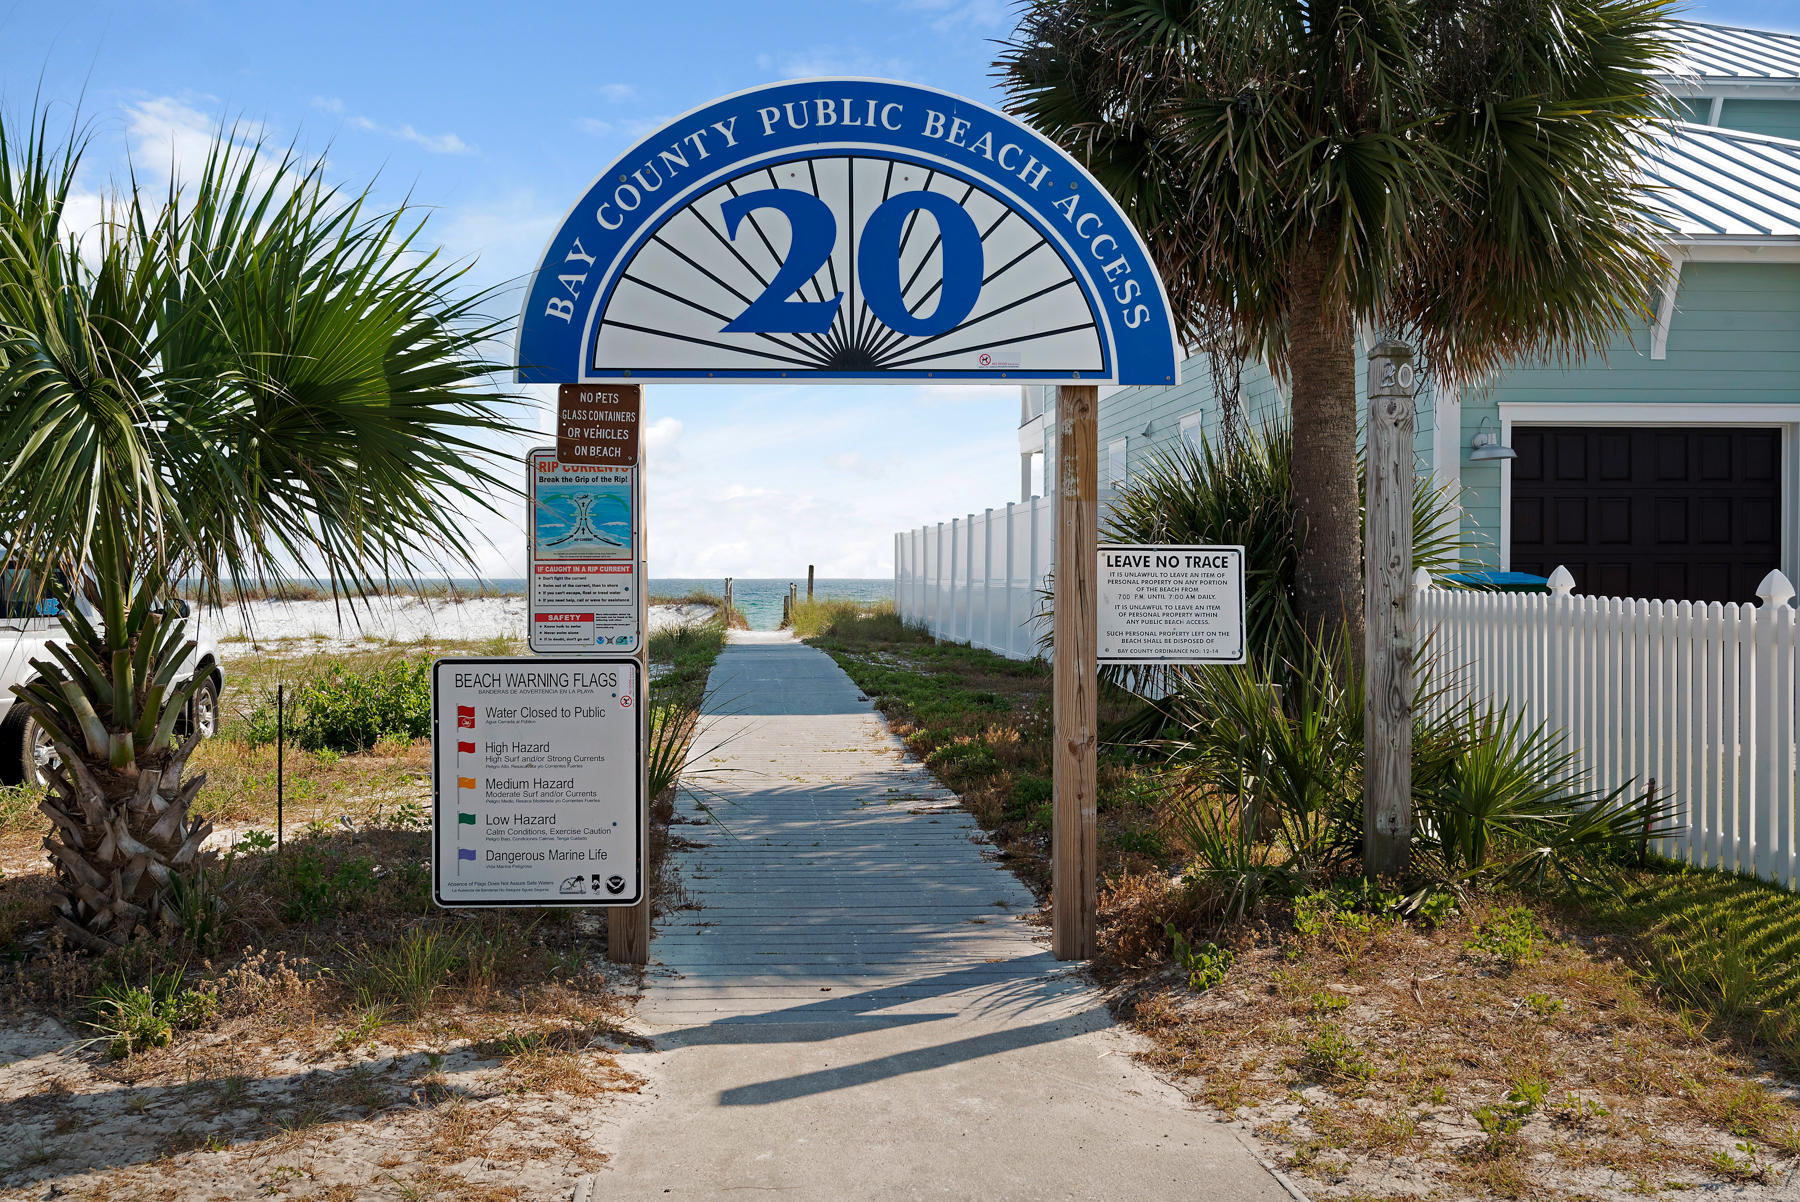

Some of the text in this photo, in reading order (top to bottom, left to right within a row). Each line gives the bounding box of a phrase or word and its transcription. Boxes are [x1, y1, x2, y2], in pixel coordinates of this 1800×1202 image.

[544, 99, 1150, 328] BAY COUNTY PUBLIC BEACH ACCESS
[718, 189, 984, 336] 20
[1380, 362, 1414, 388] 20
[580, 392, 618, 403] NO PETS
[562, 410, 635, 422] GLASS CONTAINERS
[568, 428, 628, 440] OR VEHICLES
[575, 446, 620, 457] ON BEACH
[539, 462, 558, 472] RIP
[1107, 556, 1228, 568] LEAVE NO TRACE
[456, 673, 501, 688] BEACH
[506, 673, 568, 687] WARNING
[574, 673, 616, 687] FLAGS
[486, 707, 605, 718] Water Closed to Public
[486, 742, 550, 755] High Hazard
[547, 755, 571, 764] Strong
[486, 778, 574, 789] Medium Hazard
[486, 814, 556, 825] Low Hazard
[486, 849, 607, 864] Dangerous Marine Life
